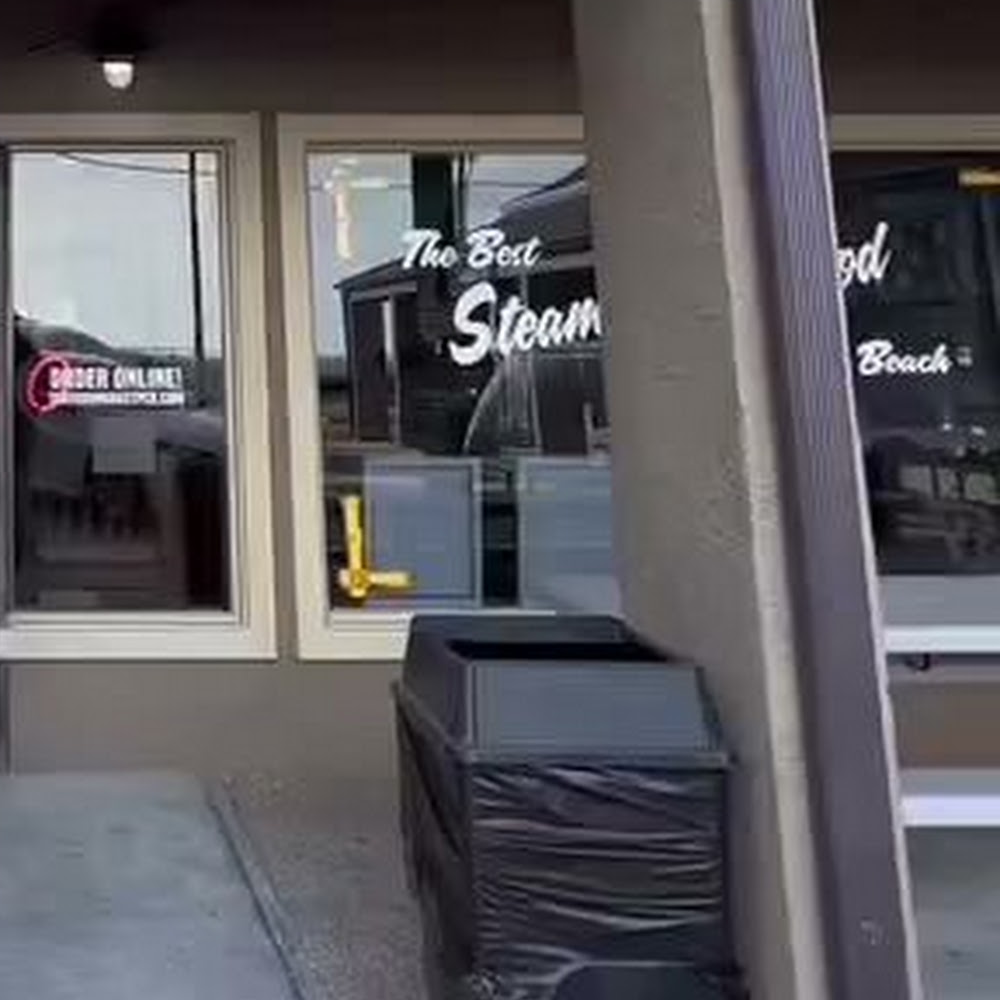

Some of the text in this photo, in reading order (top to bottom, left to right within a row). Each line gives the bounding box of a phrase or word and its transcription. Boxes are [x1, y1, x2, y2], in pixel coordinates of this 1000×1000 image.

[402, 229, 542, 269] The Best
[856, 339, 953, 375] Beach
